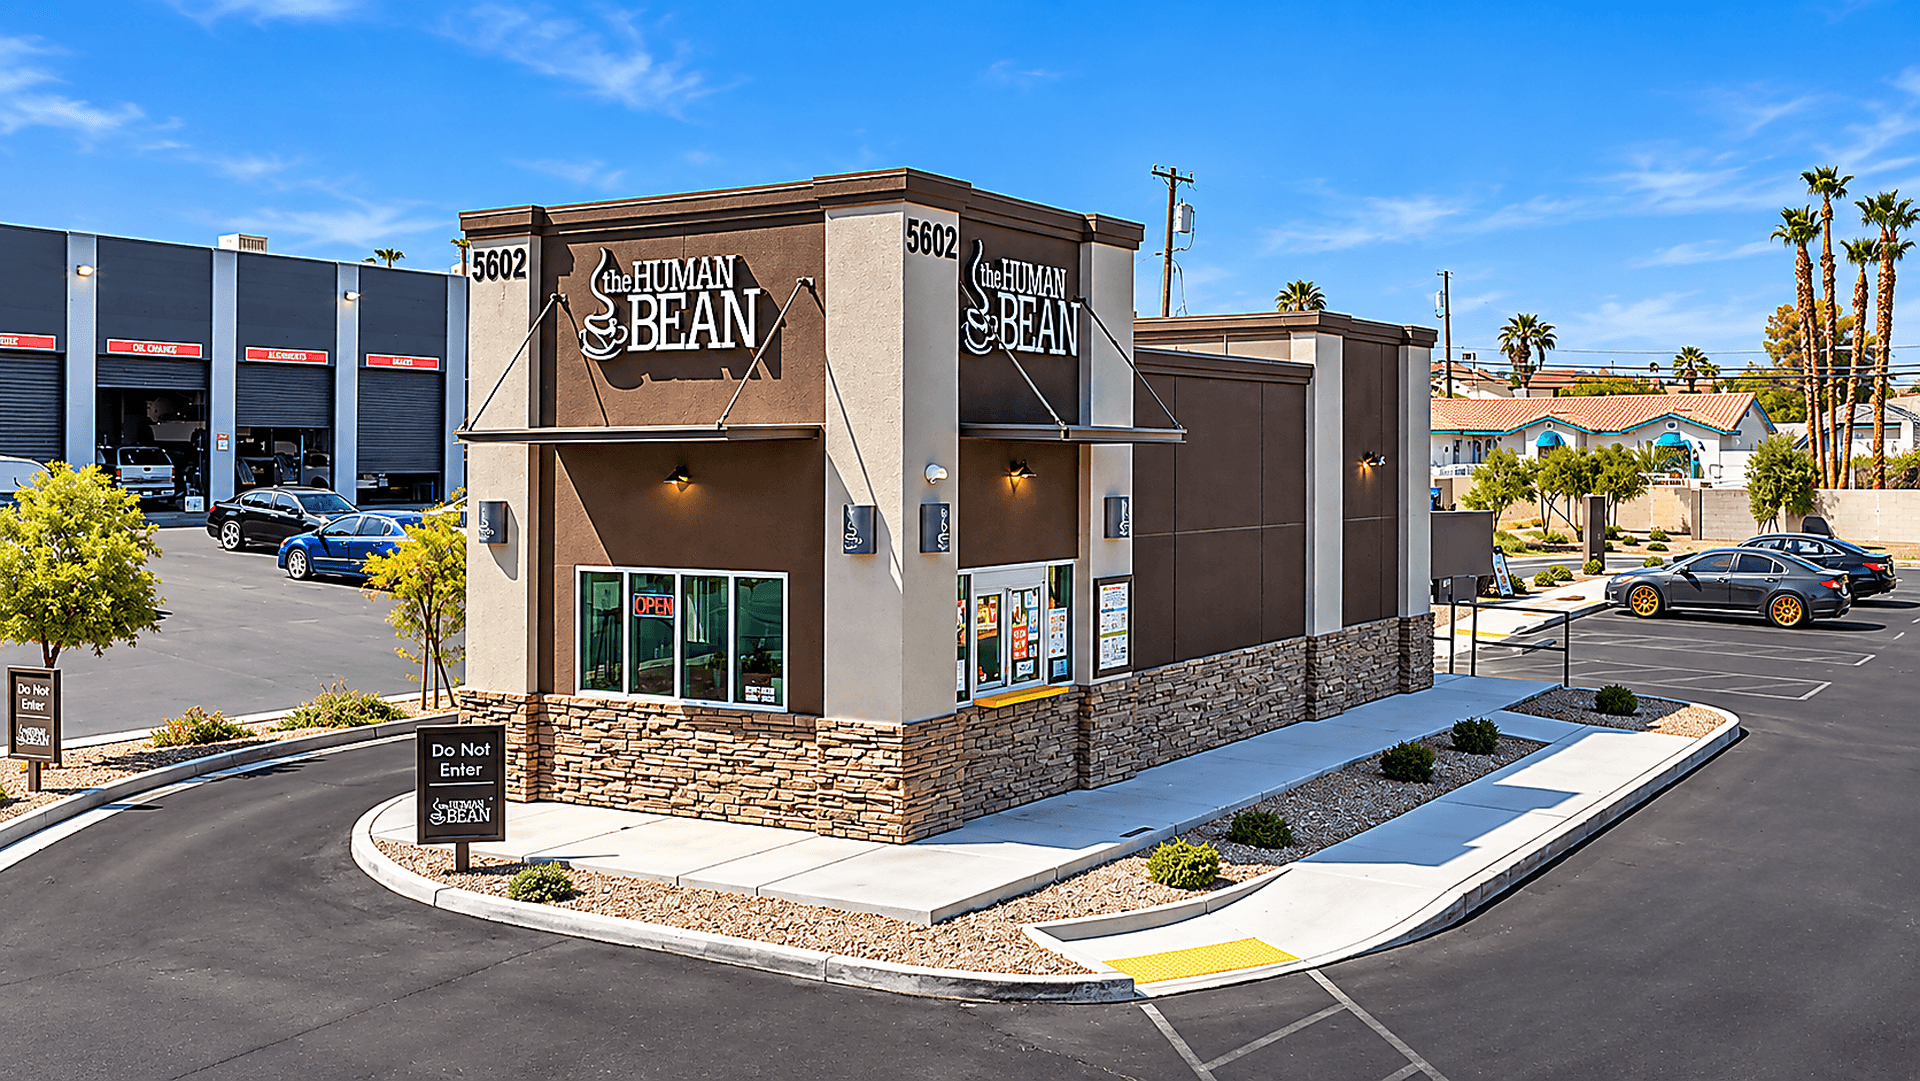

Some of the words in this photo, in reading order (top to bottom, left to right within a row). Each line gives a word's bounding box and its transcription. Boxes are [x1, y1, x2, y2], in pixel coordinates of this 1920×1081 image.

[906, 218, 958, 260] 5602
[472, 247, 527, 282] 5602
[603, 269, 632, 294] the
[631, 254, 737, 293] HUMAN
[980, 263, 1001, 288] the
[1000, 258, 1067, 299] HUMAN
[626, 287, 762, 352] BEAN
[997, 292, 1081, 357] BEAN
[633, 595, 674, 616] OPEN
[17, 683, 31, 695] Do
[32, 684, 51, 697] Not
[21, 698, 46, 711] Enter
[432, 743, 455, 757] Do
[461, 742, 491, 757] Not
[440, 762, 483, 777] Enter
[446, 807, 491, 824] BEAN
